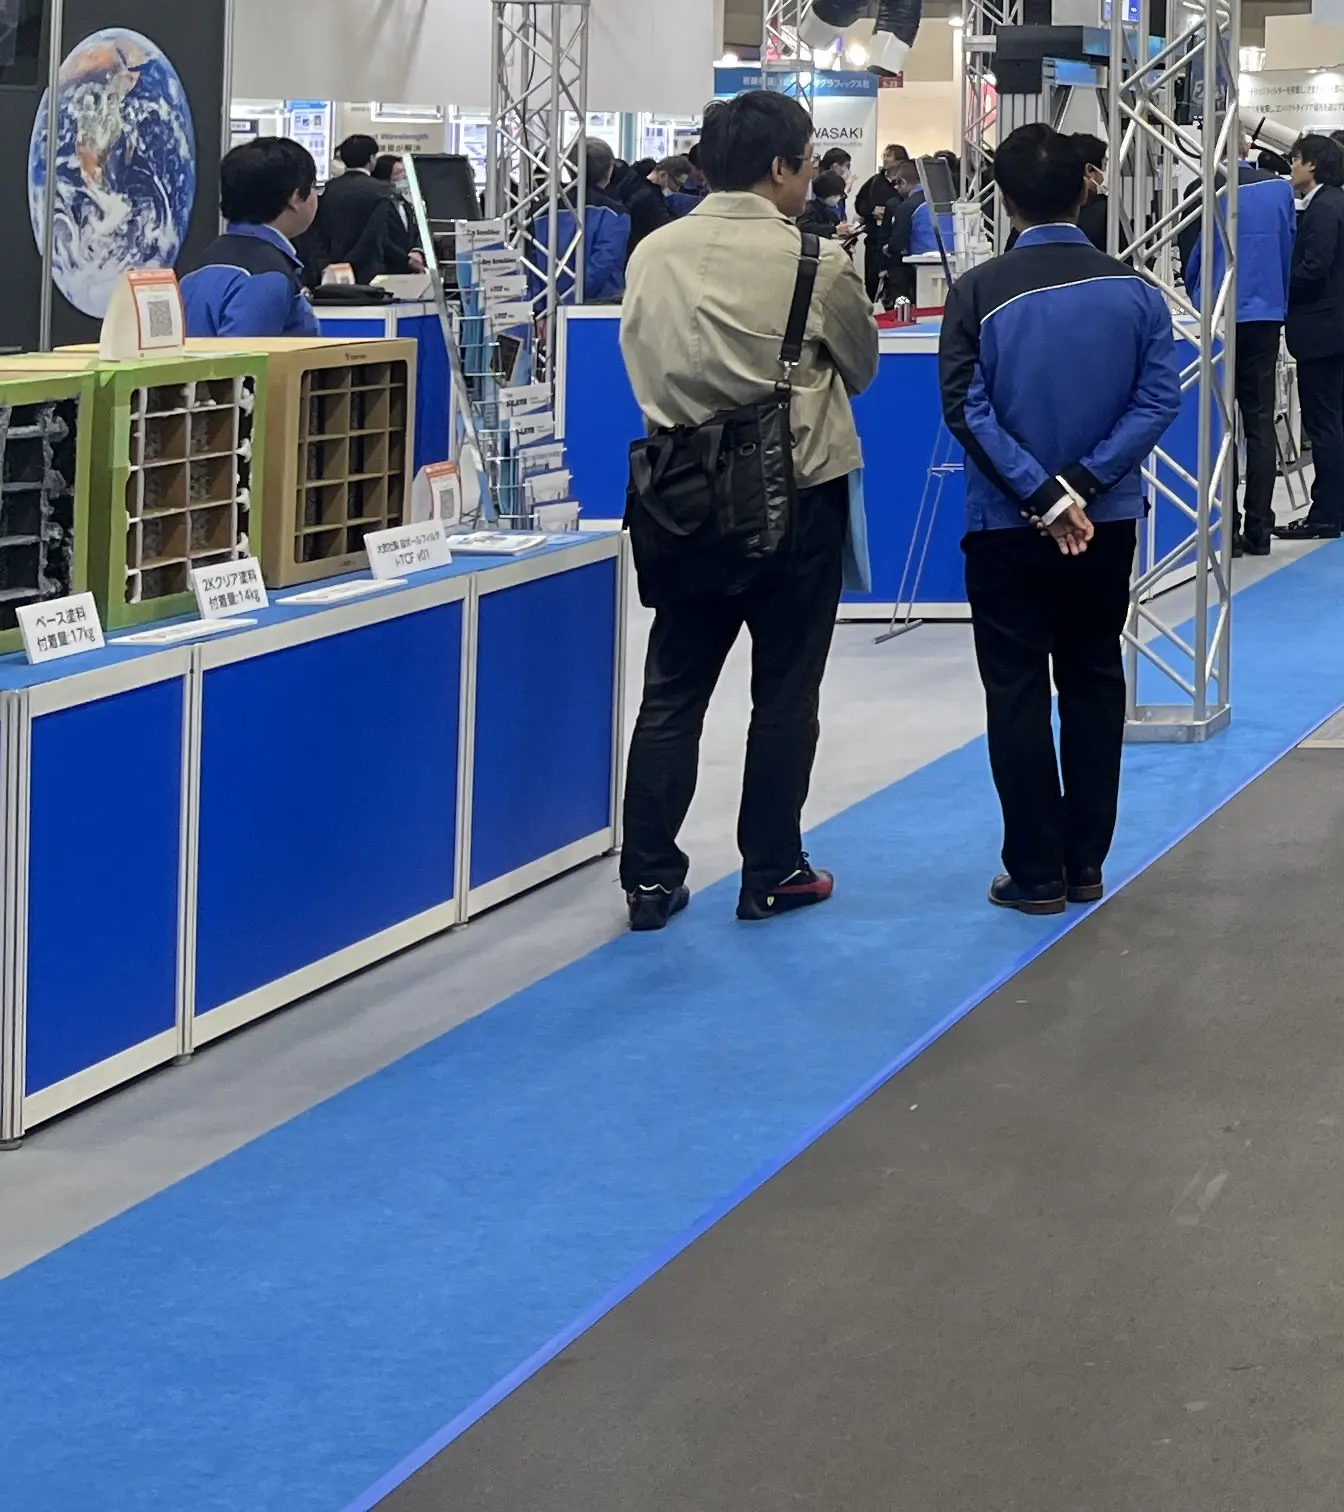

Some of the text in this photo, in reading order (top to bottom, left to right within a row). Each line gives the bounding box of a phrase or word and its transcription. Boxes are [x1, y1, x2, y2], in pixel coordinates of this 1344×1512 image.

[35, 604, 88, 629] ベース塗料
